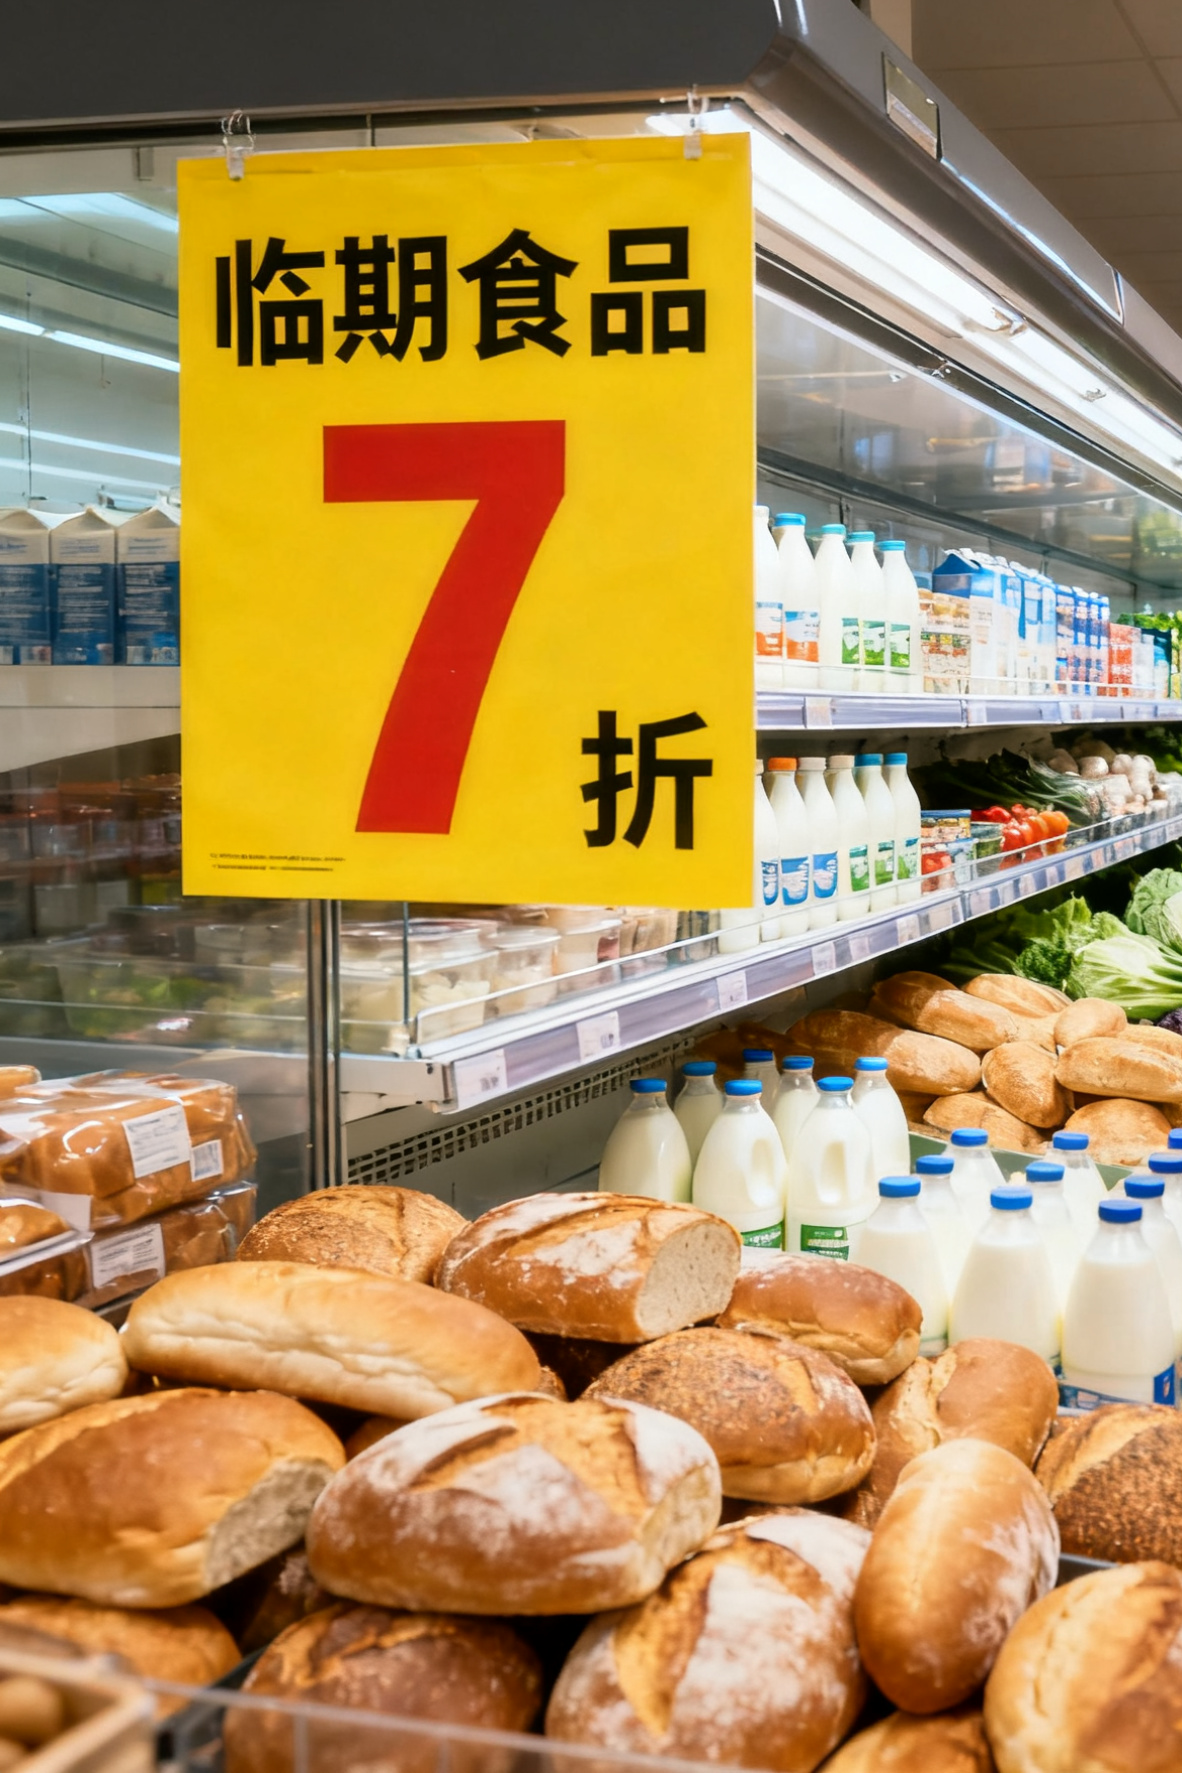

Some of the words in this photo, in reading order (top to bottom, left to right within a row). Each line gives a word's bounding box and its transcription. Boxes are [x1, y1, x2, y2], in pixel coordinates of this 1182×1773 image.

[216, 227, 706, 367] 临期食品
[322, 419, 566, 835] 7
[580, 710, 713, 850] 折
